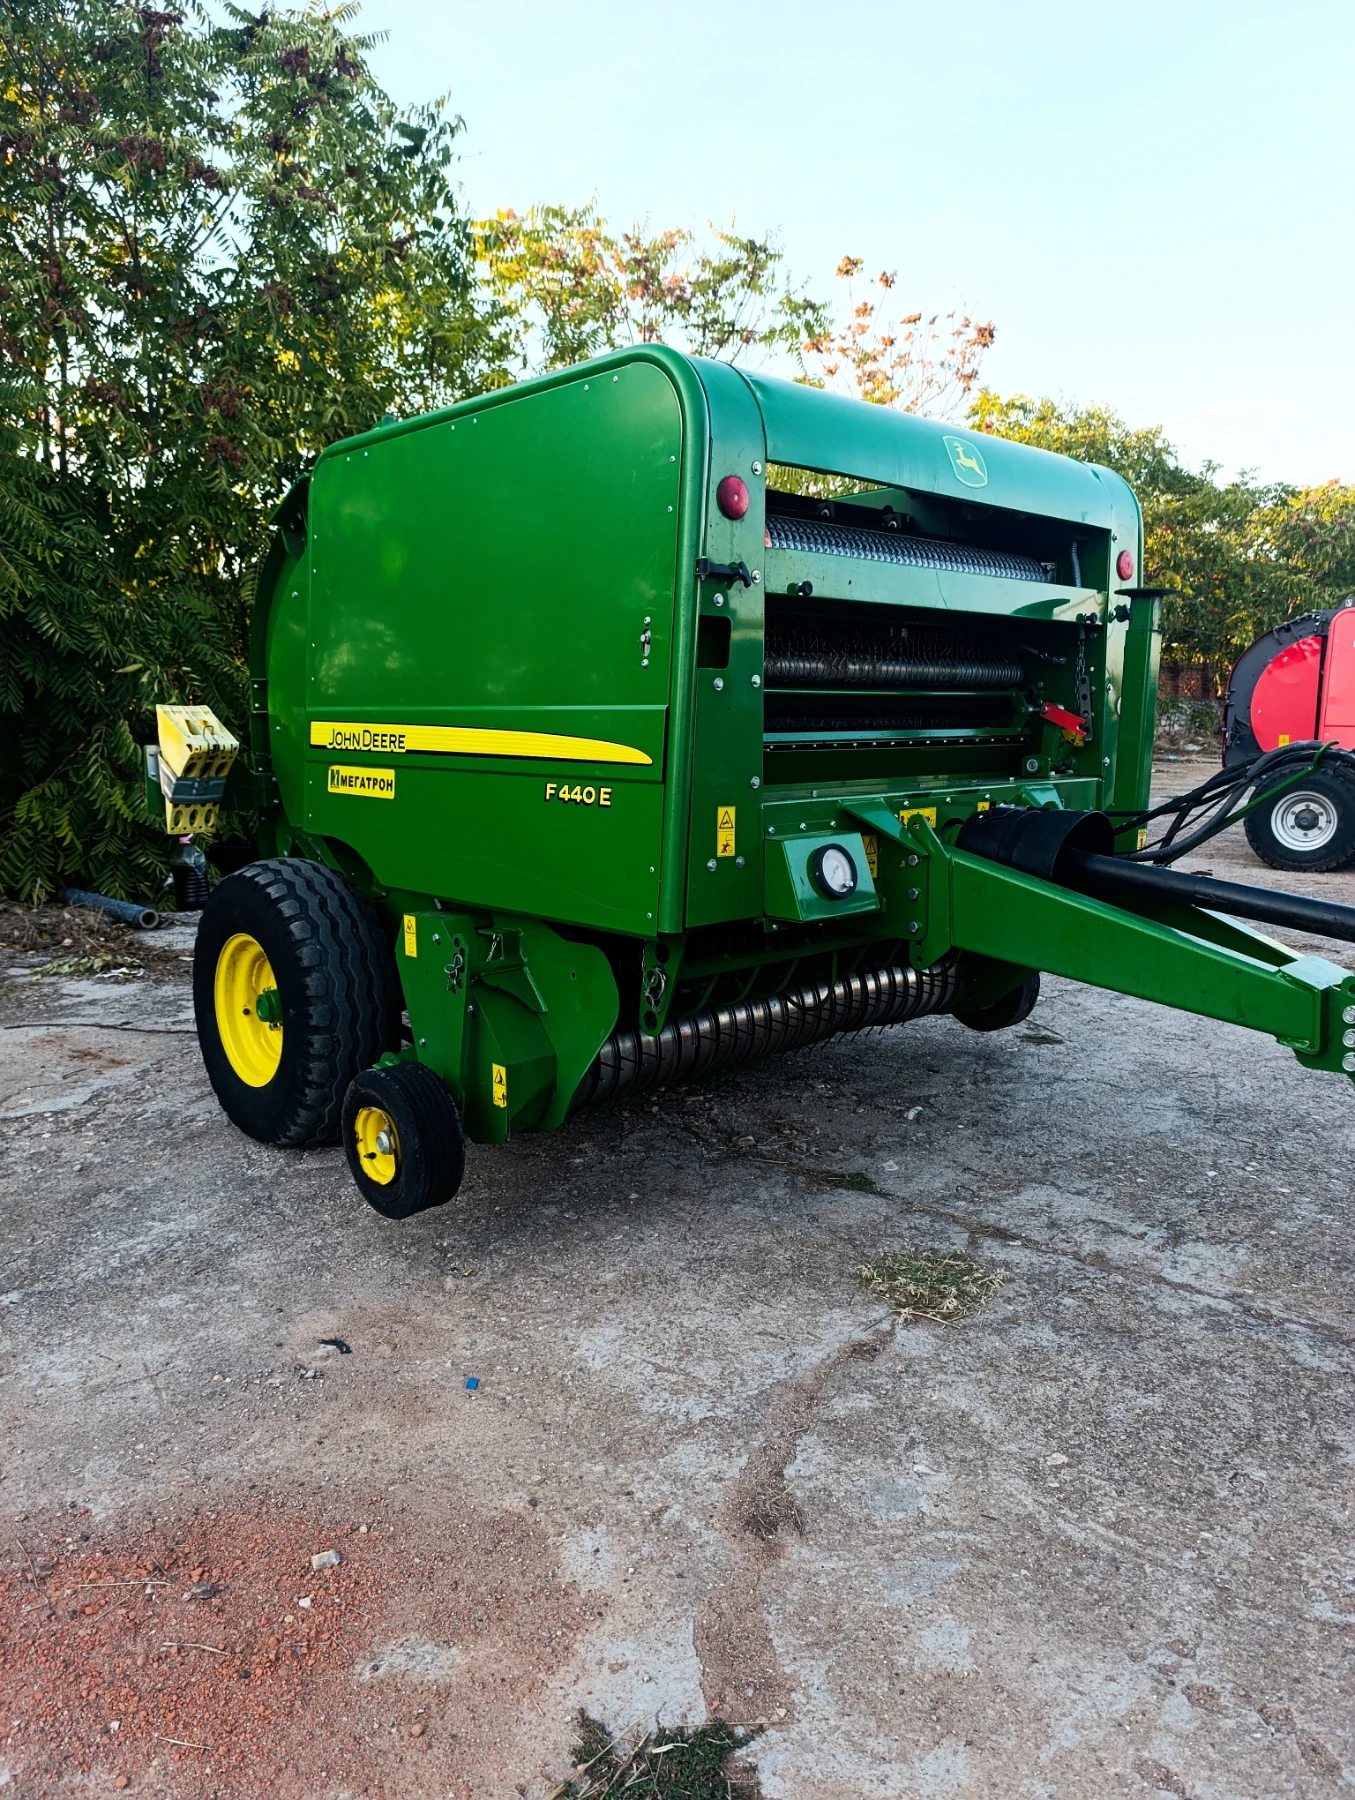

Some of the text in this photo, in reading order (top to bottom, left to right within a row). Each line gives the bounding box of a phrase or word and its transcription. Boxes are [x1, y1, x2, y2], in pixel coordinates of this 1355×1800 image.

[328, 728, 406, 750] JOHN DEERE
[341, 775, 393, 792] МЕГАТРОН
